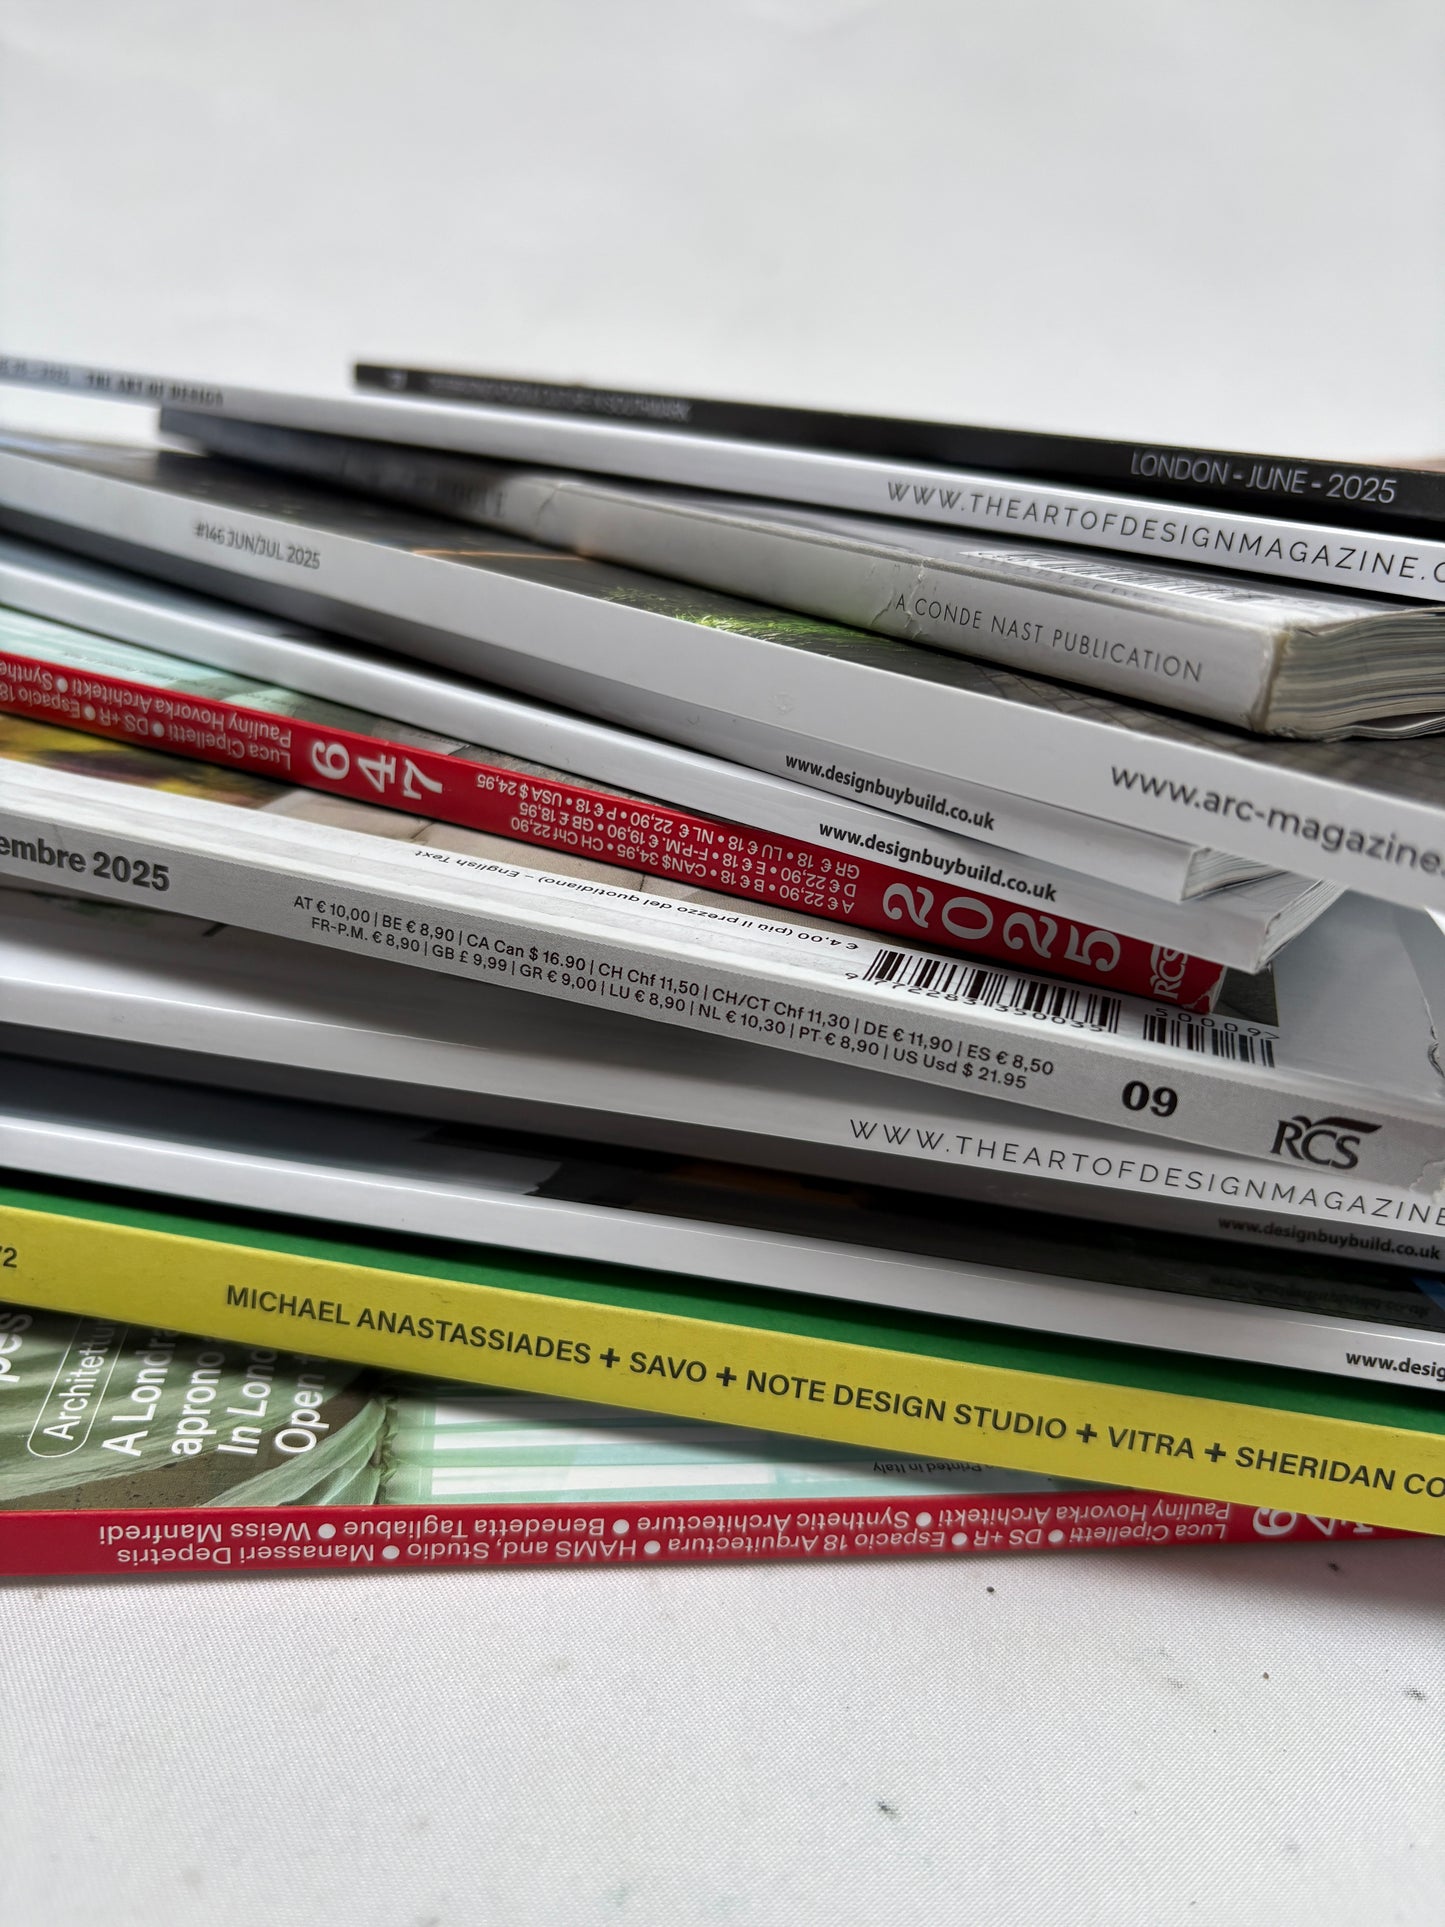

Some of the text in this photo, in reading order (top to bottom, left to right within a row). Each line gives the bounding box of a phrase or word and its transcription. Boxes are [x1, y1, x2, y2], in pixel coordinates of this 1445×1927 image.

[1130, 451, 1397, 503] LONDON JUNE 2025
[192, 520, 320, 570] #146 JUN/JUL 2025
[894, 593, 1202, 682] A CONDE NAST PUBLICATION
[168, 723, 291, 770] Luca Cipelletti
[311, 741, 443, 800] 647
[785, 754, 994, 830] www.designbuybuild.co.uk
[476, 773, 860, 879] GR € 18 LU € 18 NL € 22,90 P € 18 USA $ 24,95
[414, 849, 450, 864] Text
[455, 858, 520, 878] English
[510, 816, 854, 914] A € 22,90 B € 18 CAN$ 34,95 CH Chf 22,90
[518, 801, 856, 898] D € 22,90 E € 18 F-P.M. € 19,90 GB £ 18,95
[818, 822, 1056, 902] www.designbuybuild.co.uk
[92, 850, 169, 891] 2025
[537, 875, 640, 902] quotidiano)
[642, 898, 672, 909] del
[676, 906, 740, 923] prezzo
[740, 920, 753, 928] il
[756, 923, 793, 936] (più
[796, 932, 842, 946] 4,00
[883, 882, 1121, 973] 2025
[293, 895, 1054, 1075] AT € 10,00 BE € 8,90 CA Can $ 16.90 CH Chf 11,50 CH/CT Chf 11,30 DE € 11,90 ES € 8,50
[311, 916, 1026, 1089] FR-P.M. € 8,90 GB £ 9,99 GR € 9,00 LU € 8,90 NL € 10,30 PT € 8,90 US Usd $ 21.95
[1120, 1080, 1179, 1118] 09
[1270, 1115, 1378, 1169] RCS
[1217, 1217, 1441, 1260] www.designbuybuild.co.uk
[171, 1351, 226, 1456] aprono
[226, 1284, 350, 1325] MICHAEL
[356, 1307, 591, 1364] ANASTASSIADES
[629, 1351, 706, 1382] SAVO
[746, 1369, 826, 1402] NOTE
[832, 1383, 946, 1422] DESIGN
[952, 1403, 1066, 1439] STUDIO
[1108, 1425, 1194, 1459] VITRA
[1234, 1446, 1396, 1490] SHERIDAN
[275, 1372, 330, 1454] Open
[102, 1430, 149, 1457] A
[218, 1425, 263, 1455] In
[230, 1522, 311, 1541] Weiss
[343, 1516, 468, 1539] Tagliabue
[474, 1517, 604, 1537] Benedetta
[636, 1513, 791, 1533] Architecture
[796, 1506, 909, 1530] Synthetic
[938, 1506, 1051, 1527] Architekti
[1055, 1503, 1146, 1523] Hovorka
[99, 1523, 221, 1545] Manfredi
[116, 1517, 1228, 1566] Luca Cipelletti DS +R Espacio 18 Arquitectura HAMS and, Studio Manasseri Depetris
